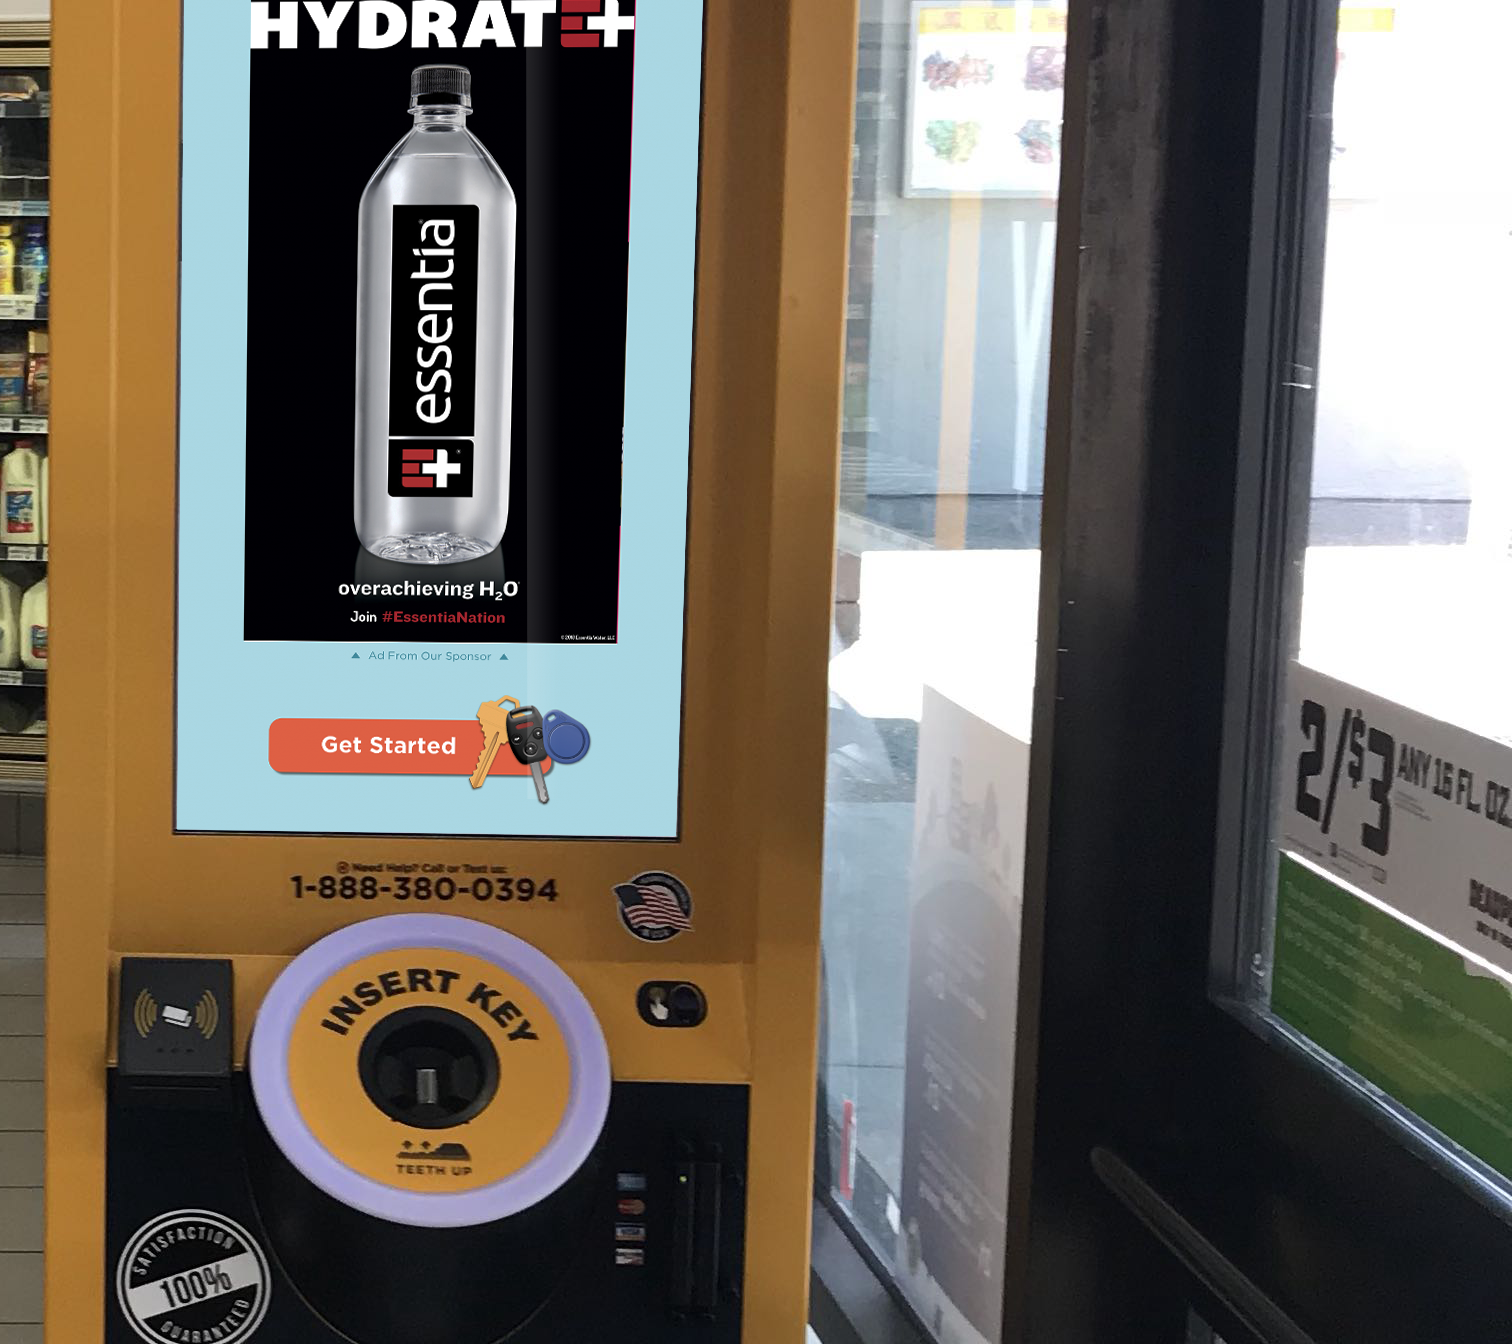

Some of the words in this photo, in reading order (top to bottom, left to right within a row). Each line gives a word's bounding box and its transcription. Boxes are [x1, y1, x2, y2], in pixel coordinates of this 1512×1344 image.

[410, 218, 456, 424] essentia
[338, 581, 474, 599] overachieving
[350, 610, 377, 624] Join
[382, 610, 506, 624] #EssentiaNation
[368, 650, 384, 660] Ad
[386, 650, 418, 661] From
[420, 651, 443, 662] Our
[445, 651, 492, 664] Sponsor
[321, 735, 362, 754] Get
[369, 736, 457, 755] Started
[1397, 743, 1432, 789] ANY
[290, 875, 559, 903] 1-888-380-0394
[320, 968, 462, 1037] INSERT
[465, 982, 540, 1042] KEY
[396, 1164, 446, 1176] TEETH
[451, 1166, 473, 1177] UP
[132, 1226, 236, 1276] SATISFACTION
[159, 1263, 233, 1308] 100%
[160, 1299, 250, 1344] GUARANTEED
